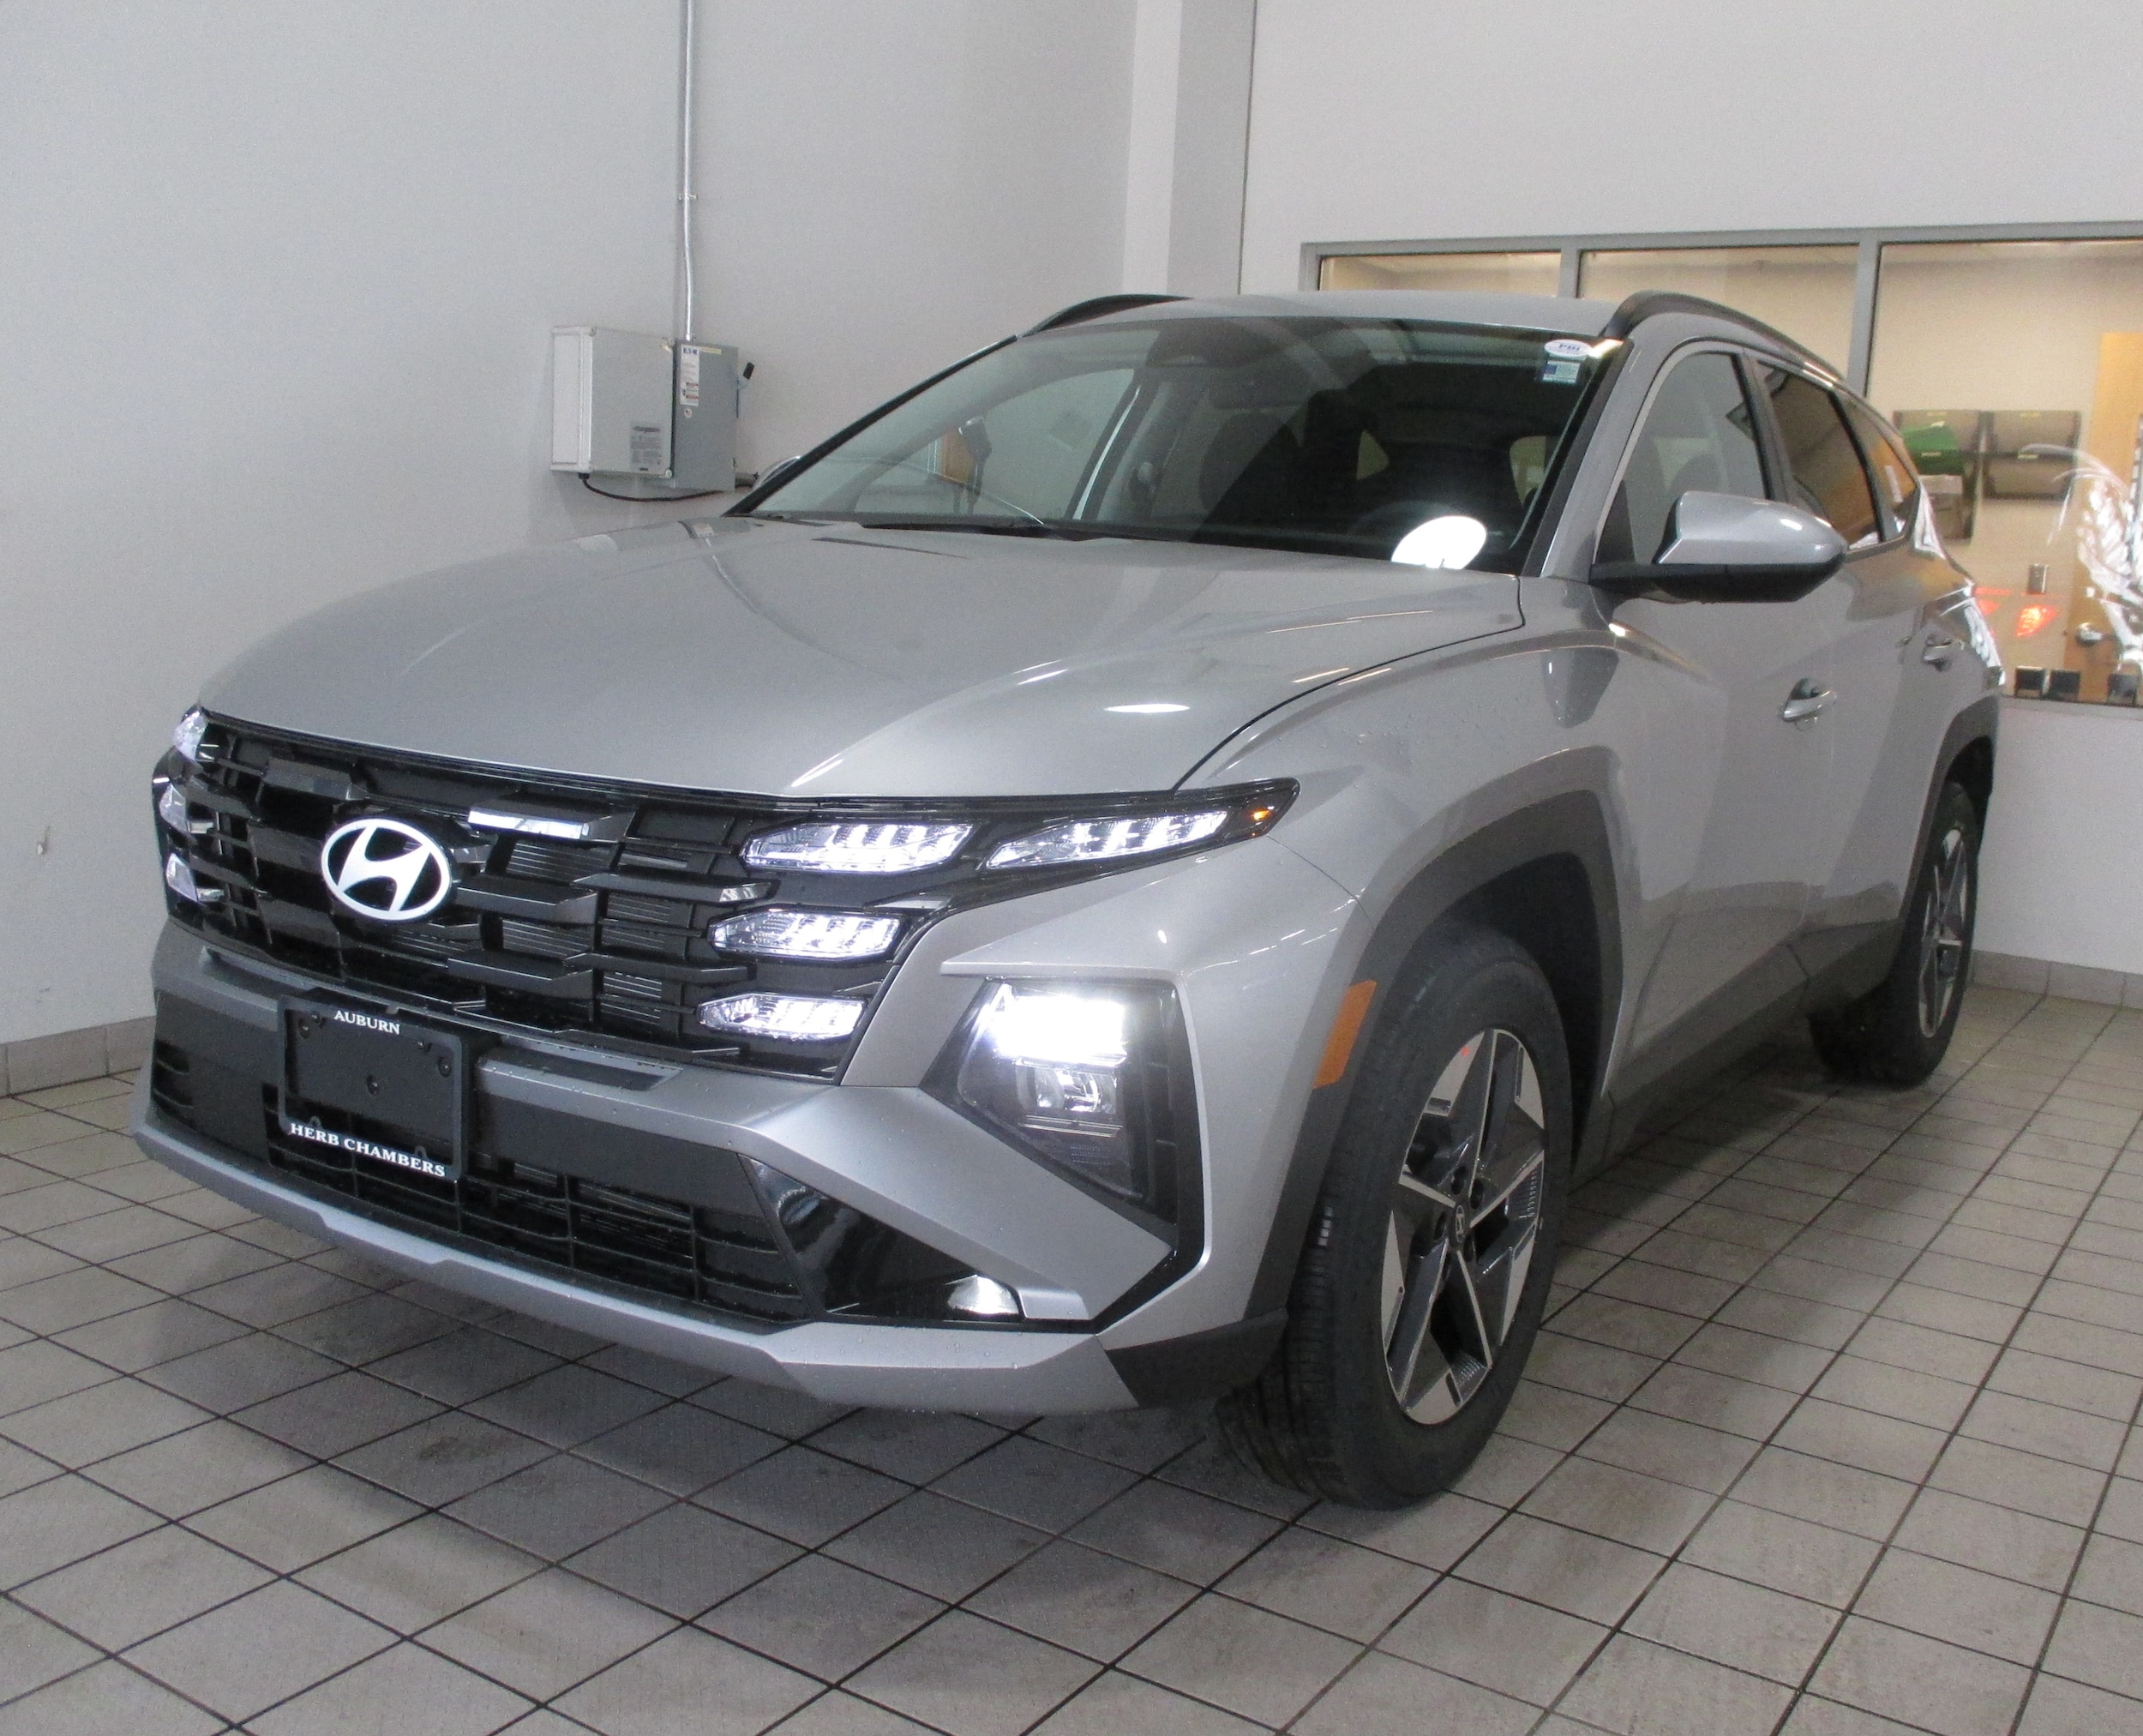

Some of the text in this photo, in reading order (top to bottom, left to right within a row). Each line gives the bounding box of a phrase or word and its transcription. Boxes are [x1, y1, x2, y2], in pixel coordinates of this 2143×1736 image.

[333, 1010, 400, 1036] AUBURN
[290, 1122, 446, 1178] HERB CHAMBERS
